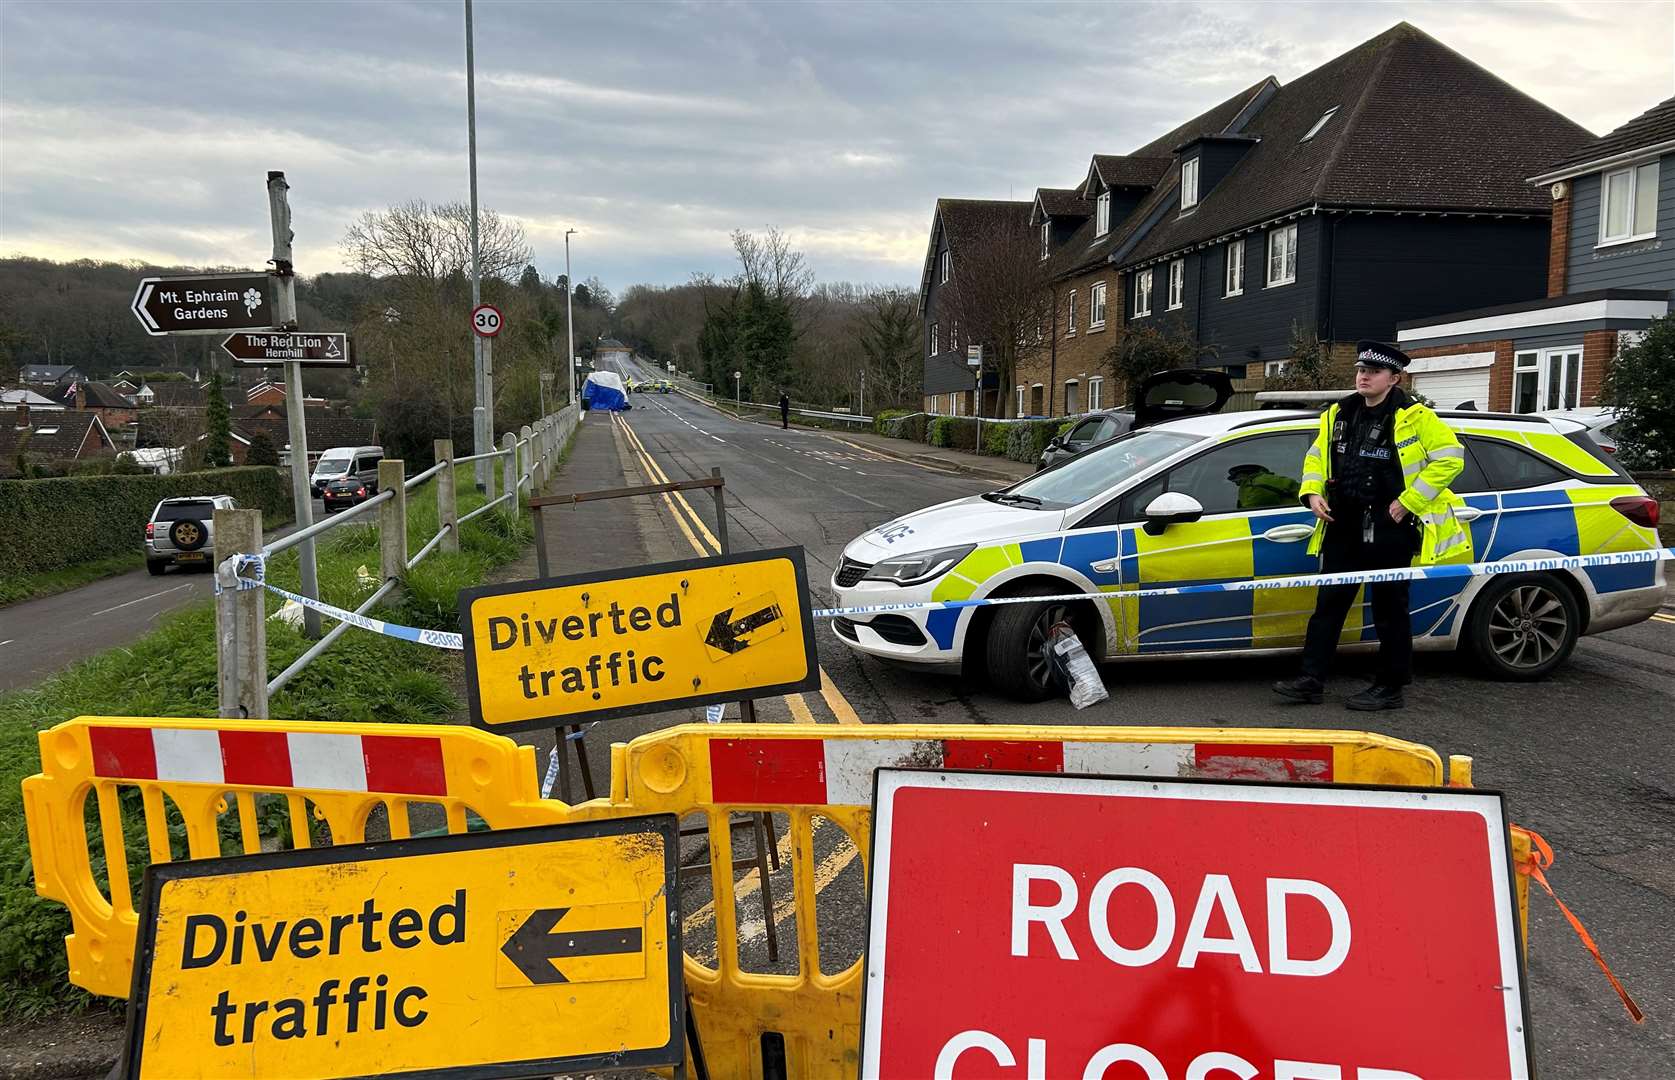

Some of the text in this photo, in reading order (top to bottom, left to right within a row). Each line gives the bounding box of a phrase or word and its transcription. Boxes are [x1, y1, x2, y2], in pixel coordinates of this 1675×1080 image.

[160, 289, 239, 305] Mt. Ephraim
[174, 307, 229, 320] Gardens
[476, 314, 498, 327] 30
[245, 335, 322, 348] The Red Lion
[265, 348, 303, 358] Hernhill
[1360, 448, 1390, 458] POLICE
[488, 593, 682, 651] Diverted
[518, 650, 665, 699] traffic
[1011, 862, 1352, 977] ROAD
[181, 888, 466, 970] Diverted
[210, 975, 429, 1047] traffic
